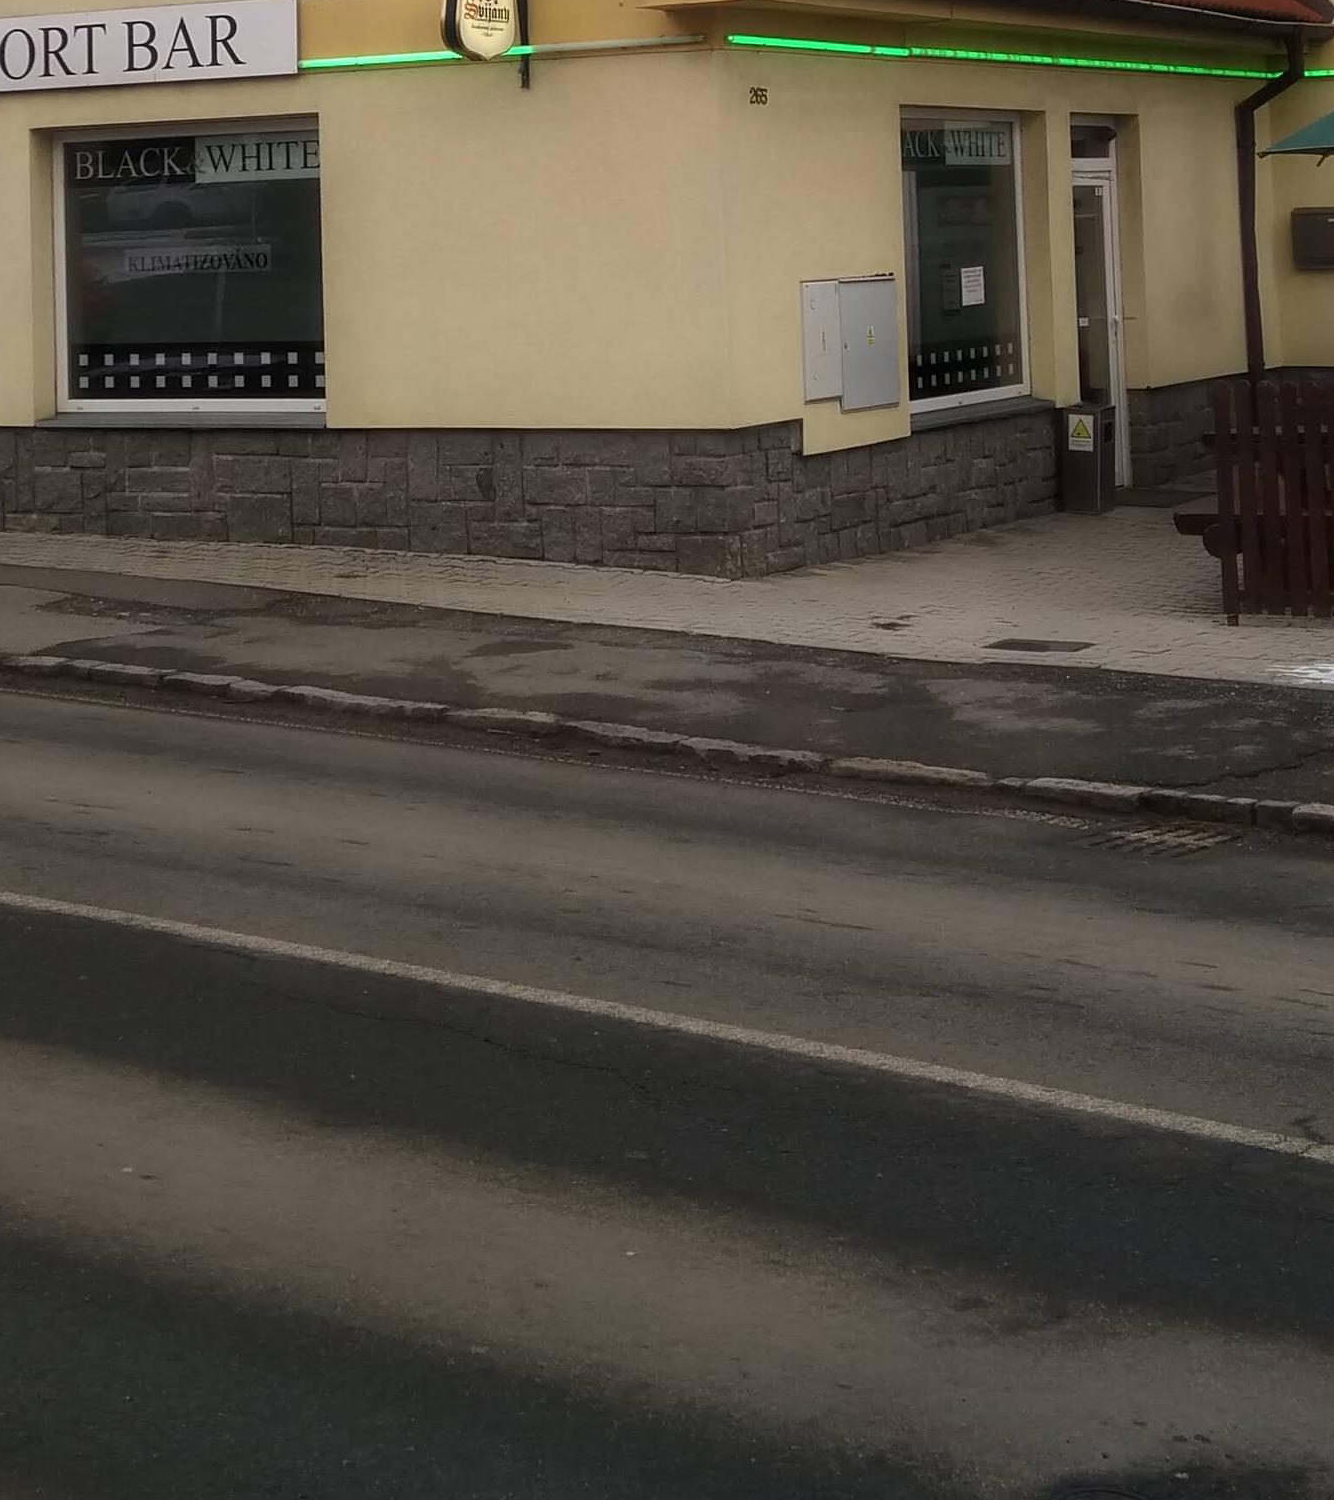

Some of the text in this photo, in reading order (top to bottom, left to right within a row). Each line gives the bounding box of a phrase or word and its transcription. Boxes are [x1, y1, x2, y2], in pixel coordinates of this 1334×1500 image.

[122, 14, 246, 73] BAR
[749, 86, 768, 105] 265
[951, 130, 1007, 158] WHITE
[74, 146, 186, 180] BLACK
[205, 139, 320, 173] WHITE
[128, 249, 269, 272] KLIMATIZOVÁNO
